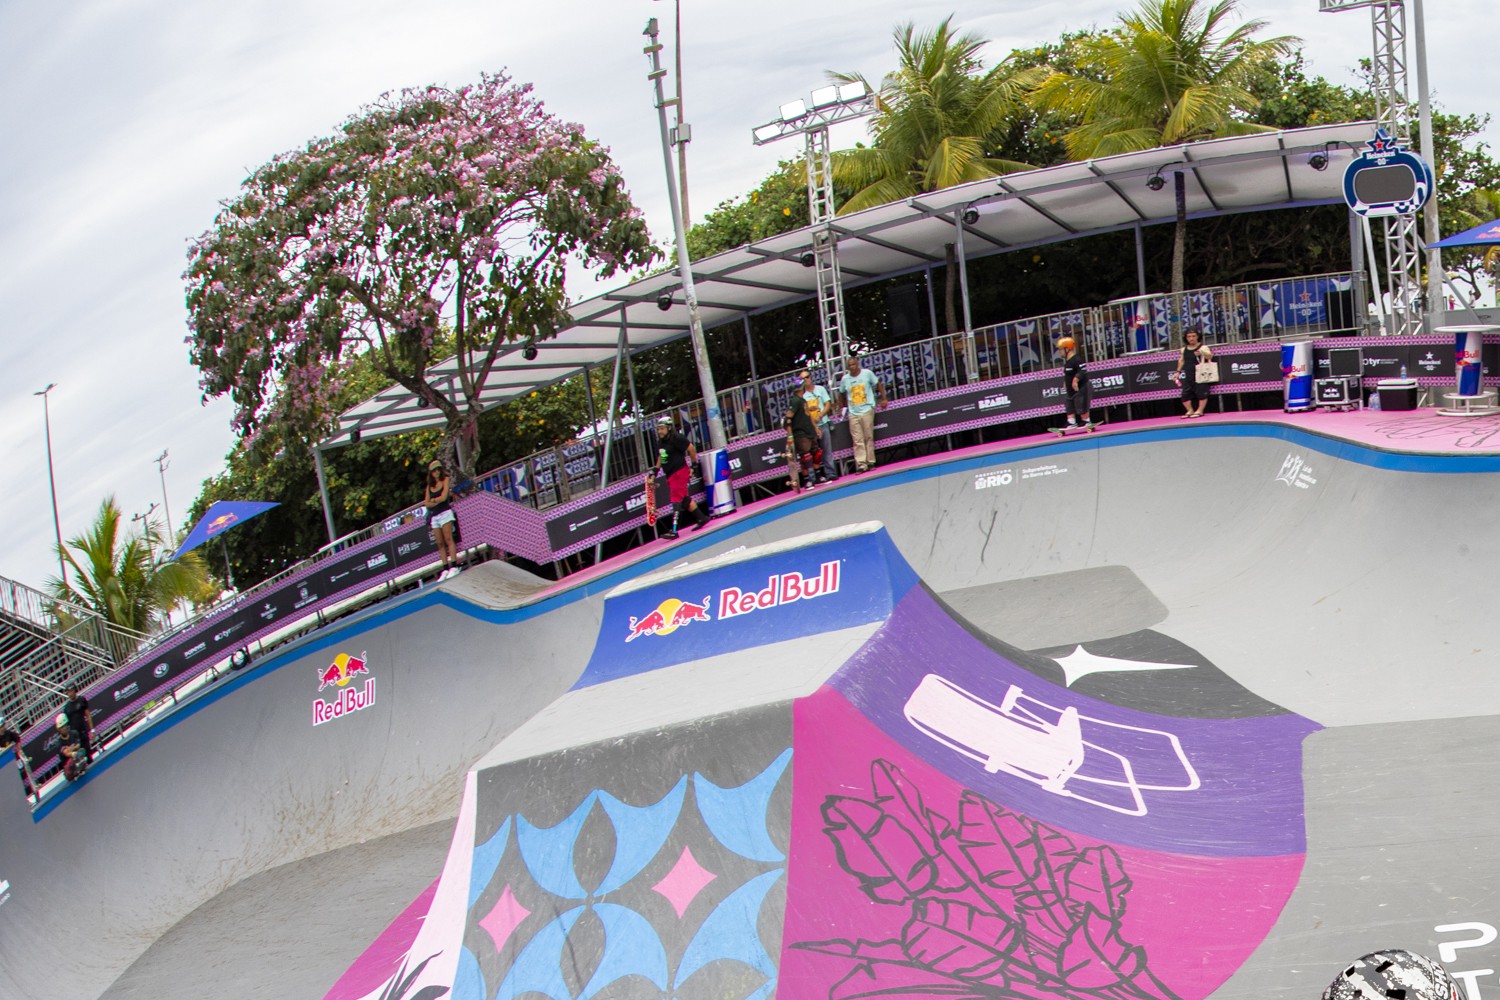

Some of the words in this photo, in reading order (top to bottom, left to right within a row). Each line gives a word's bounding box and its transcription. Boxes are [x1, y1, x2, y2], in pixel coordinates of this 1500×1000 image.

[1103, 374, 1124, 386] STU
[728, 458, 742, 470] TU
[987, 473, 1012, 488] RIO
[718, 574, 779, 620] Red
[778, 560, 841, 606] Bull
[313, 689, 345, 726] Red
[344, 677, 376, 715] Bull
